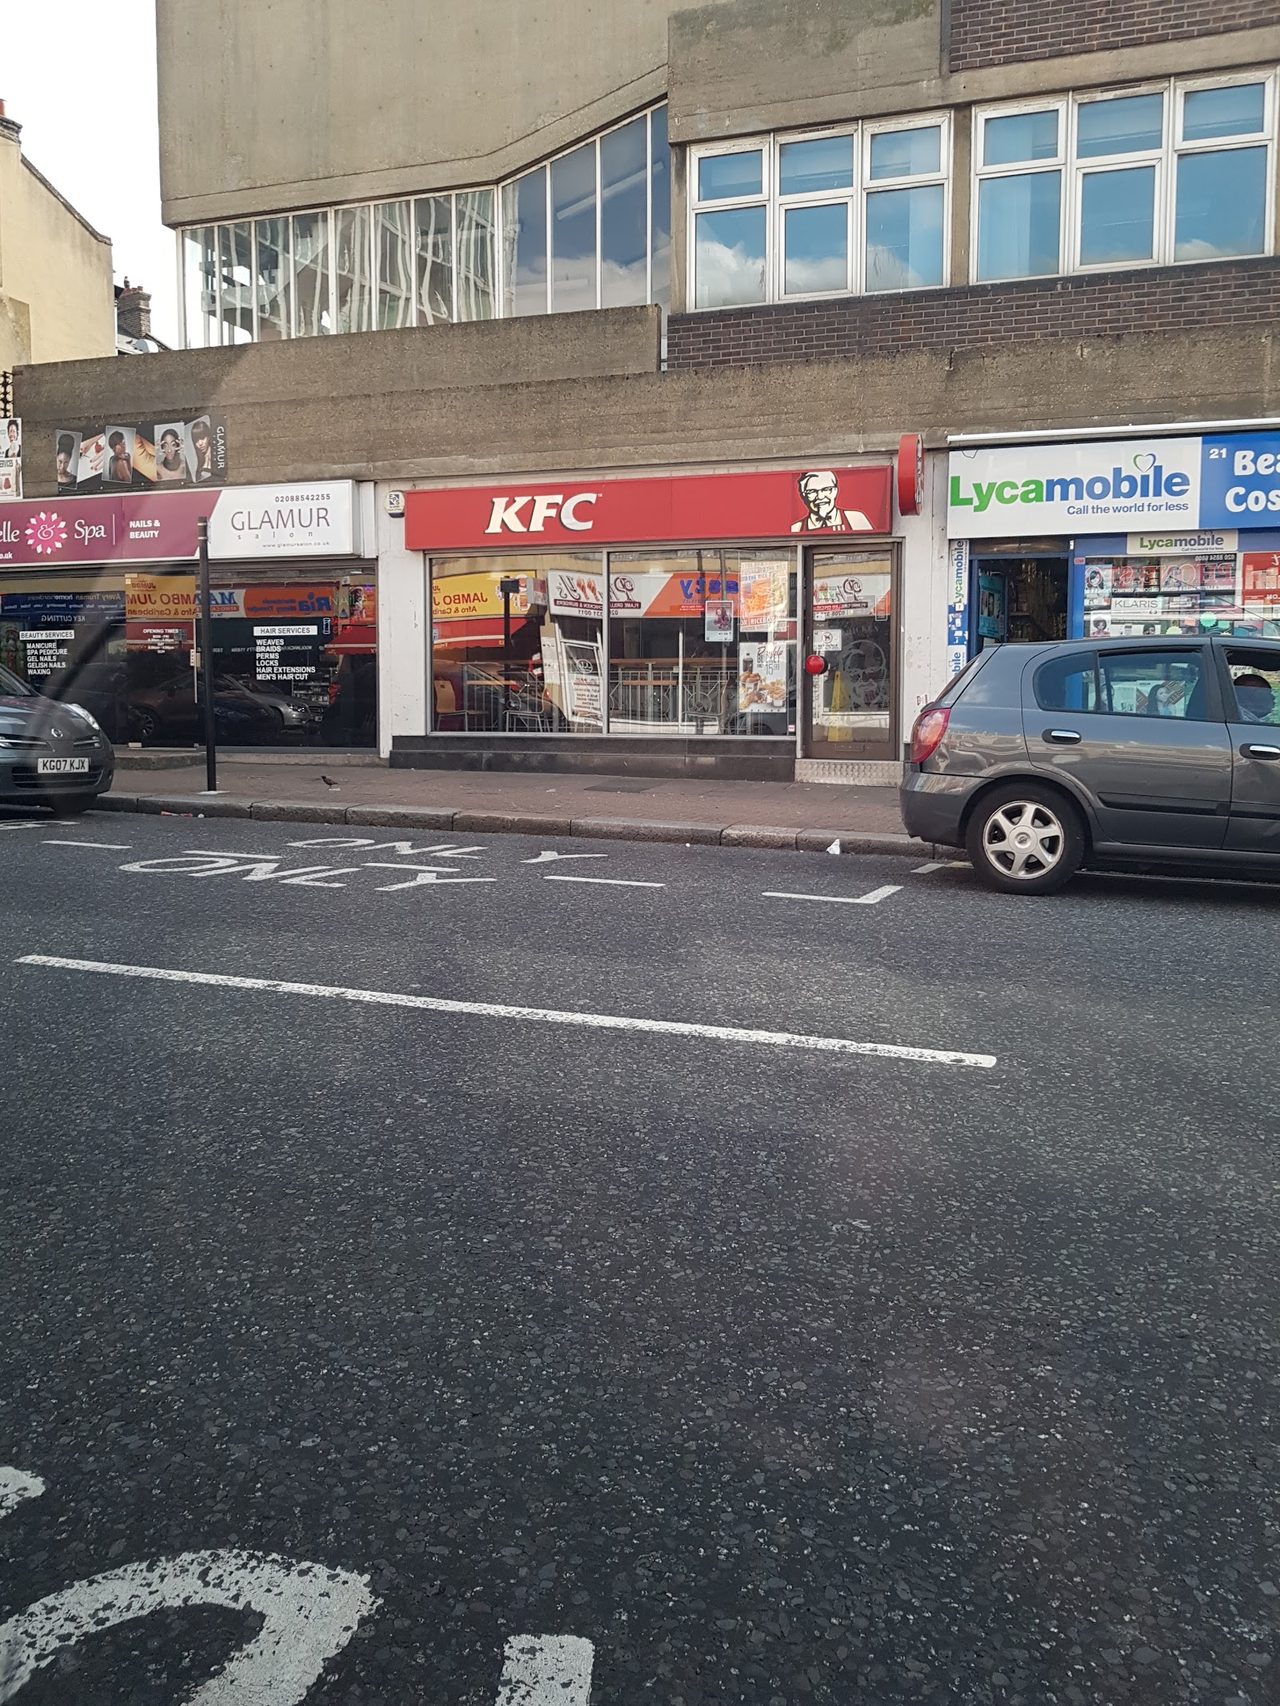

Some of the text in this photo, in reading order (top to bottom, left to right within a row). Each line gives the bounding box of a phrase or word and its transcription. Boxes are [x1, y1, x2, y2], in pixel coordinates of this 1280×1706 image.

[216, 426, 225, 469] GLAMUR
[1208, 447, 1227, 459] 21
[1234, 450, 1280, 476] Be
[949, 464, 1190, 513] Lycamobile
[274, 493, 331, 503] 02088542255
[484, 492, 597, 534] KFC
[1066, 501, 1189, 516] Call the world for less
[129, 520, 153, 528] NAILS
[231, 507, 330, 531] GLAMUR
[74, 519, 107, 546] Spa
[129, 530, 159, 539] BEAUTY
[1139, 534, 1224, 550] Lycamobile
[1114, 598, 1159, 608] KLARIS
[20, 631, 43, 639] BEAUTY
[273, 666, 316, 674] EXTENSIONS
[42, 759, 86, 771] KG07 KJX
